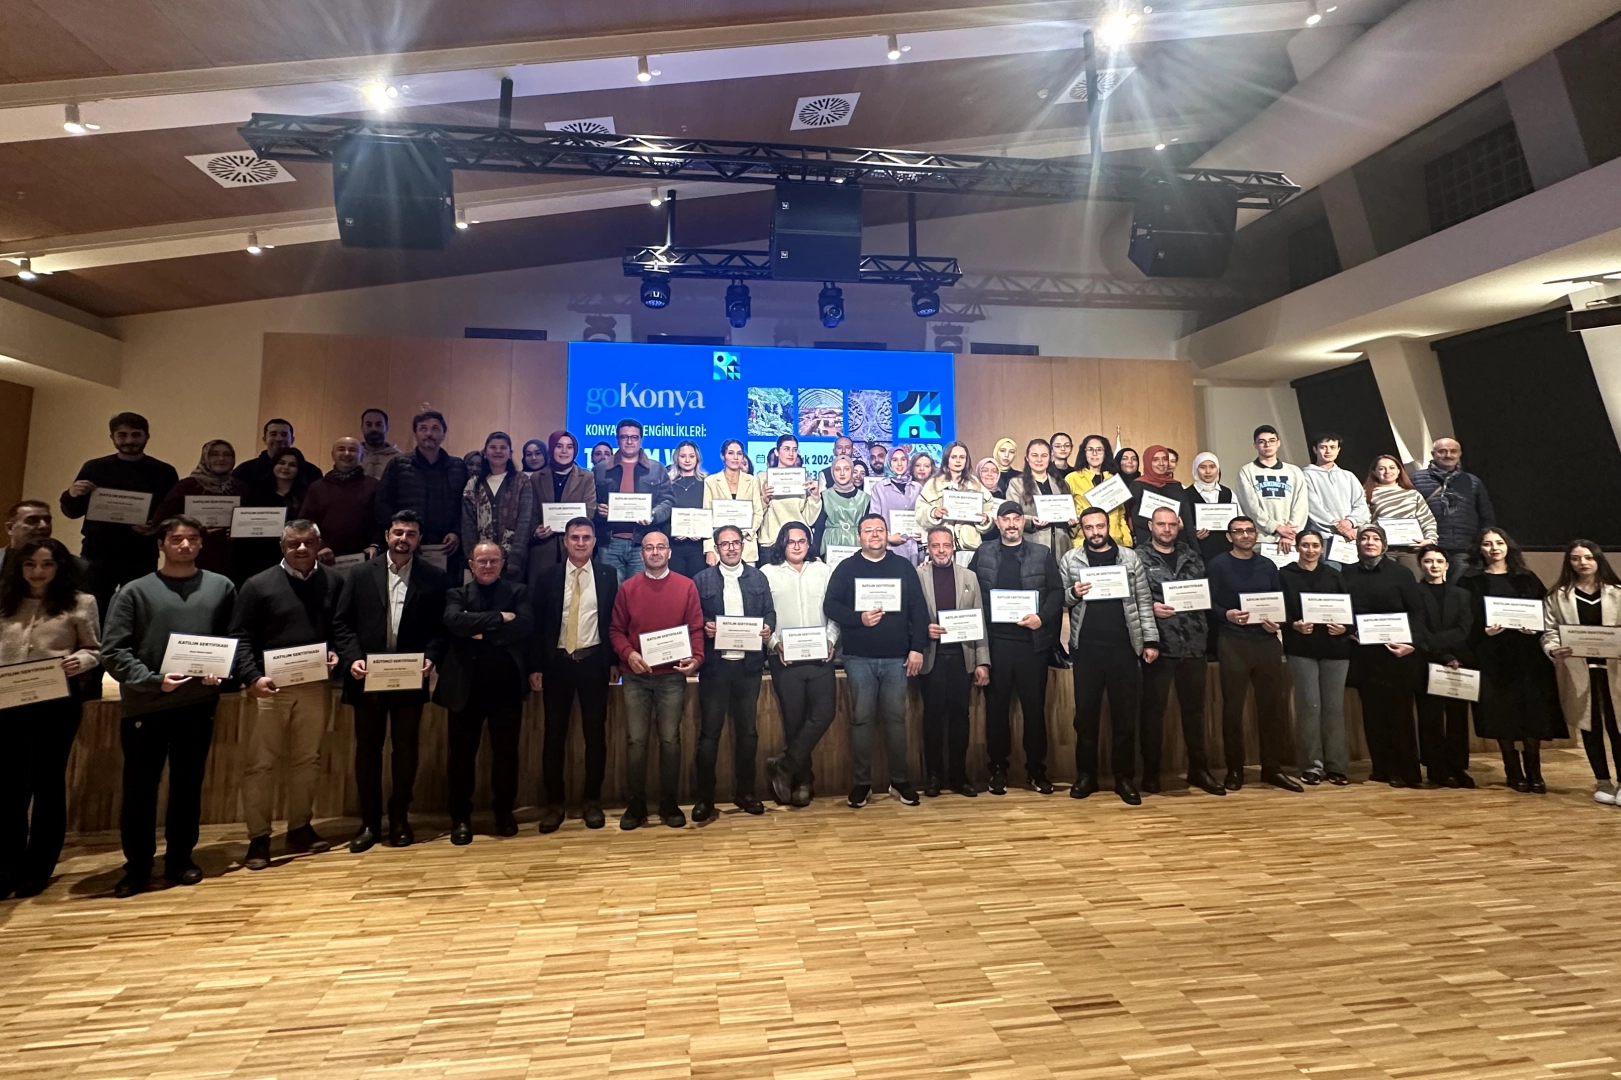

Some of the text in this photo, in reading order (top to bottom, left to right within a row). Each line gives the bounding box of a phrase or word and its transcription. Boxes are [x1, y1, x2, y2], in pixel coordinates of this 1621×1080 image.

[586, 382, 706, 416] goKonya
[586, 423, 707, 437] KONYA' ENGİNLİKLERİ:
